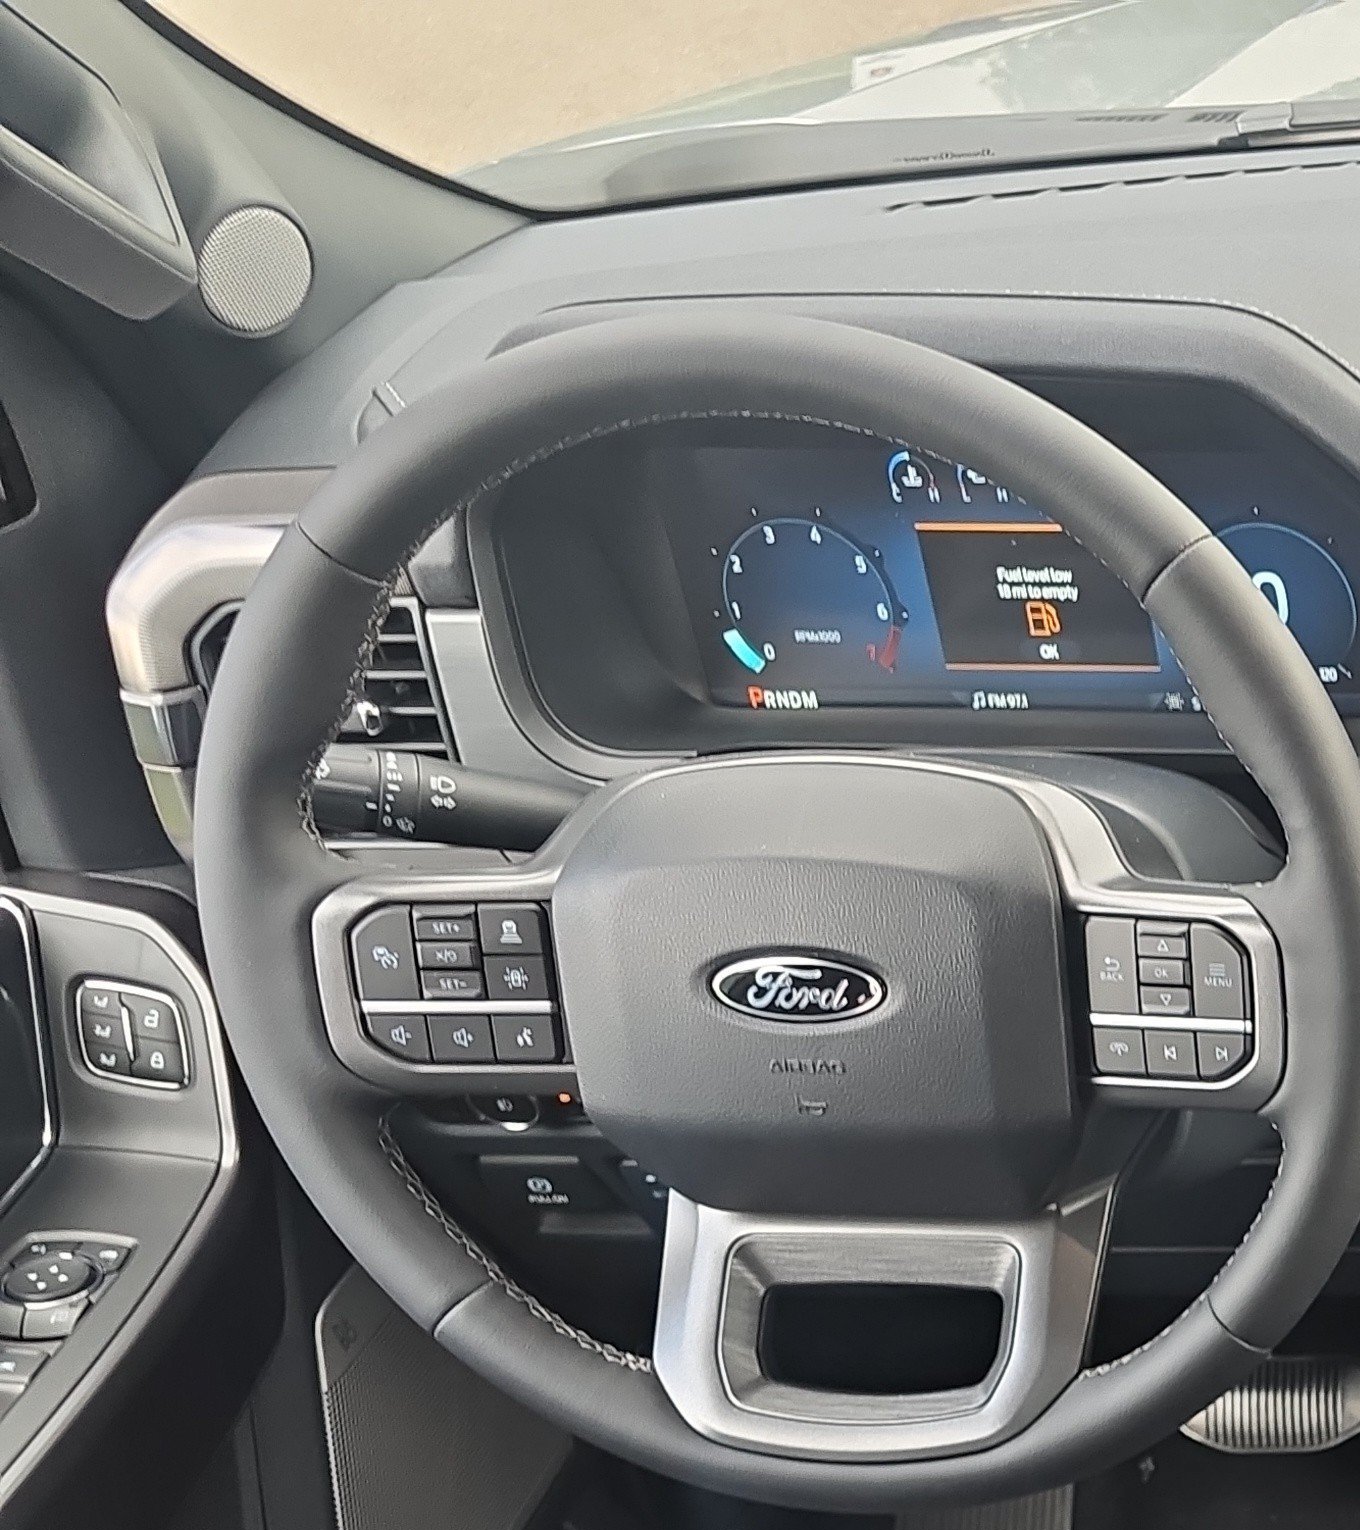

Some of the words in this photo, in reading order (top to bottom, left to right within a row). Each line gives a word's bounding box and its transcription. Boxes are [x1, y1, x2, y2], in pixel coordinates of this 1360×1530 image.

[762, 525, 775, 545] 3
[810, 525, 822, 545] 4
[729, 554, 743, 574] 2
[854, 554, 867, 574] 5
[996, 566, 1022, 583] Fuel
[1022, 566, 1049, 583] level
[1049, 567, 1073, 583] low
[1011, 584, 1028, 600] mi
[1028, 584, 1042, 600] to
[1042, 585, 1079, 602] empty
[732, 602, 741, 620] 1
[877, 602, 889, 621] 6
[763, 643, 776, 661] 0
[1039, 643, 1060, 661] OK
[1099, 971, 1124, 981] BACK
[1154, 968, 1168, 979] OK
[1204, 976, 1232, 988] MENU
[747, 965, 849, 1011] Ford
